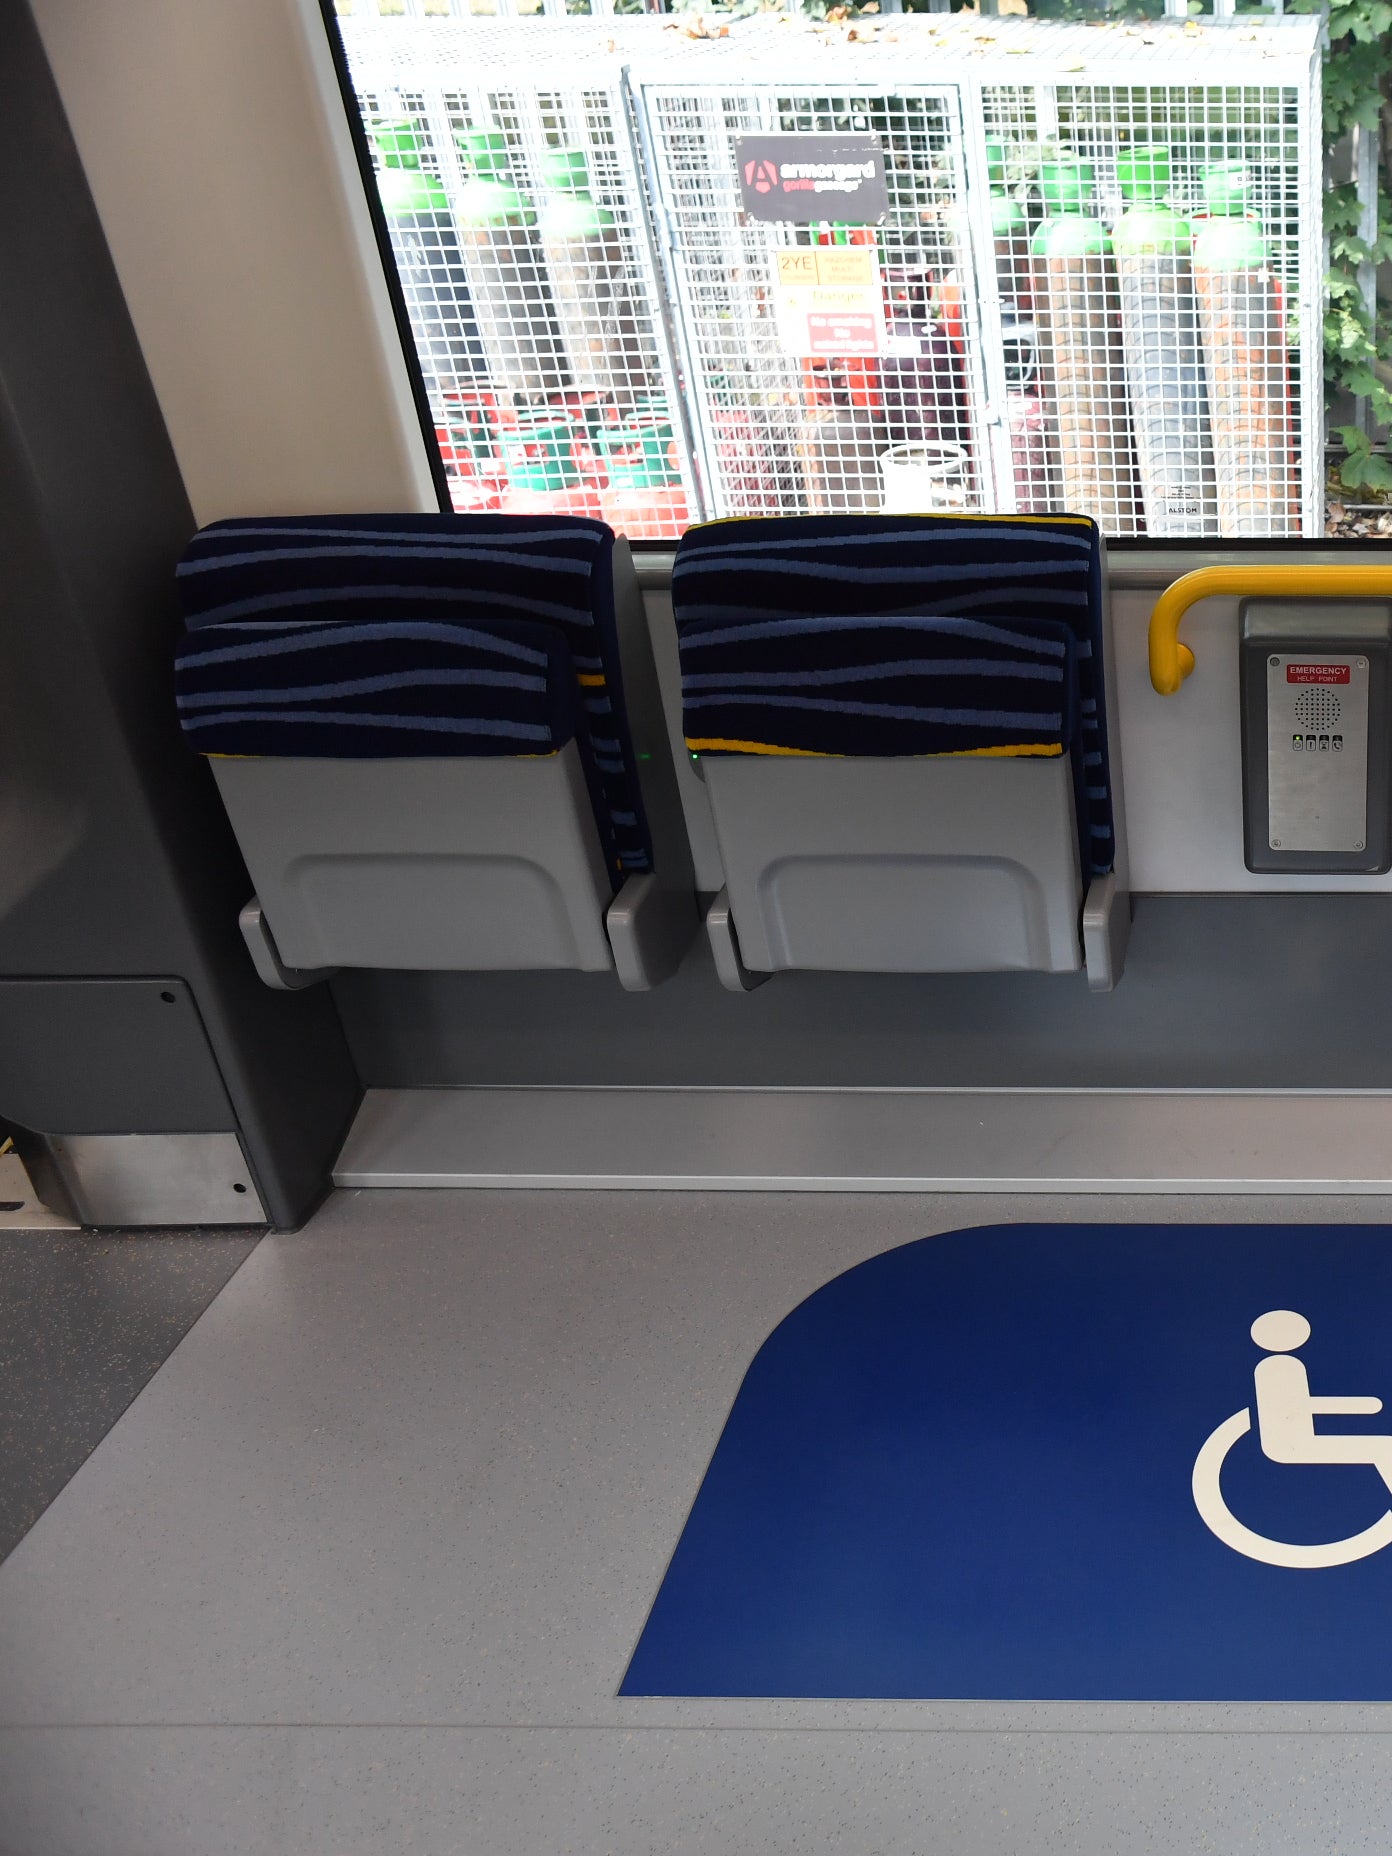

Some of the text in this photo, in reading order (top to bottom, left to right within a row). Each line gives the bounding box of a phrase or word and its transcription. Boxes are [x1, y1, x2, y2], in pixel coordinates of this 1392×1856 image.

[780, 160, 875, 181] armorgard
[781, 256, 813, 270] 2YE
[1290, 666, 1347, 675] EMERGENCY
